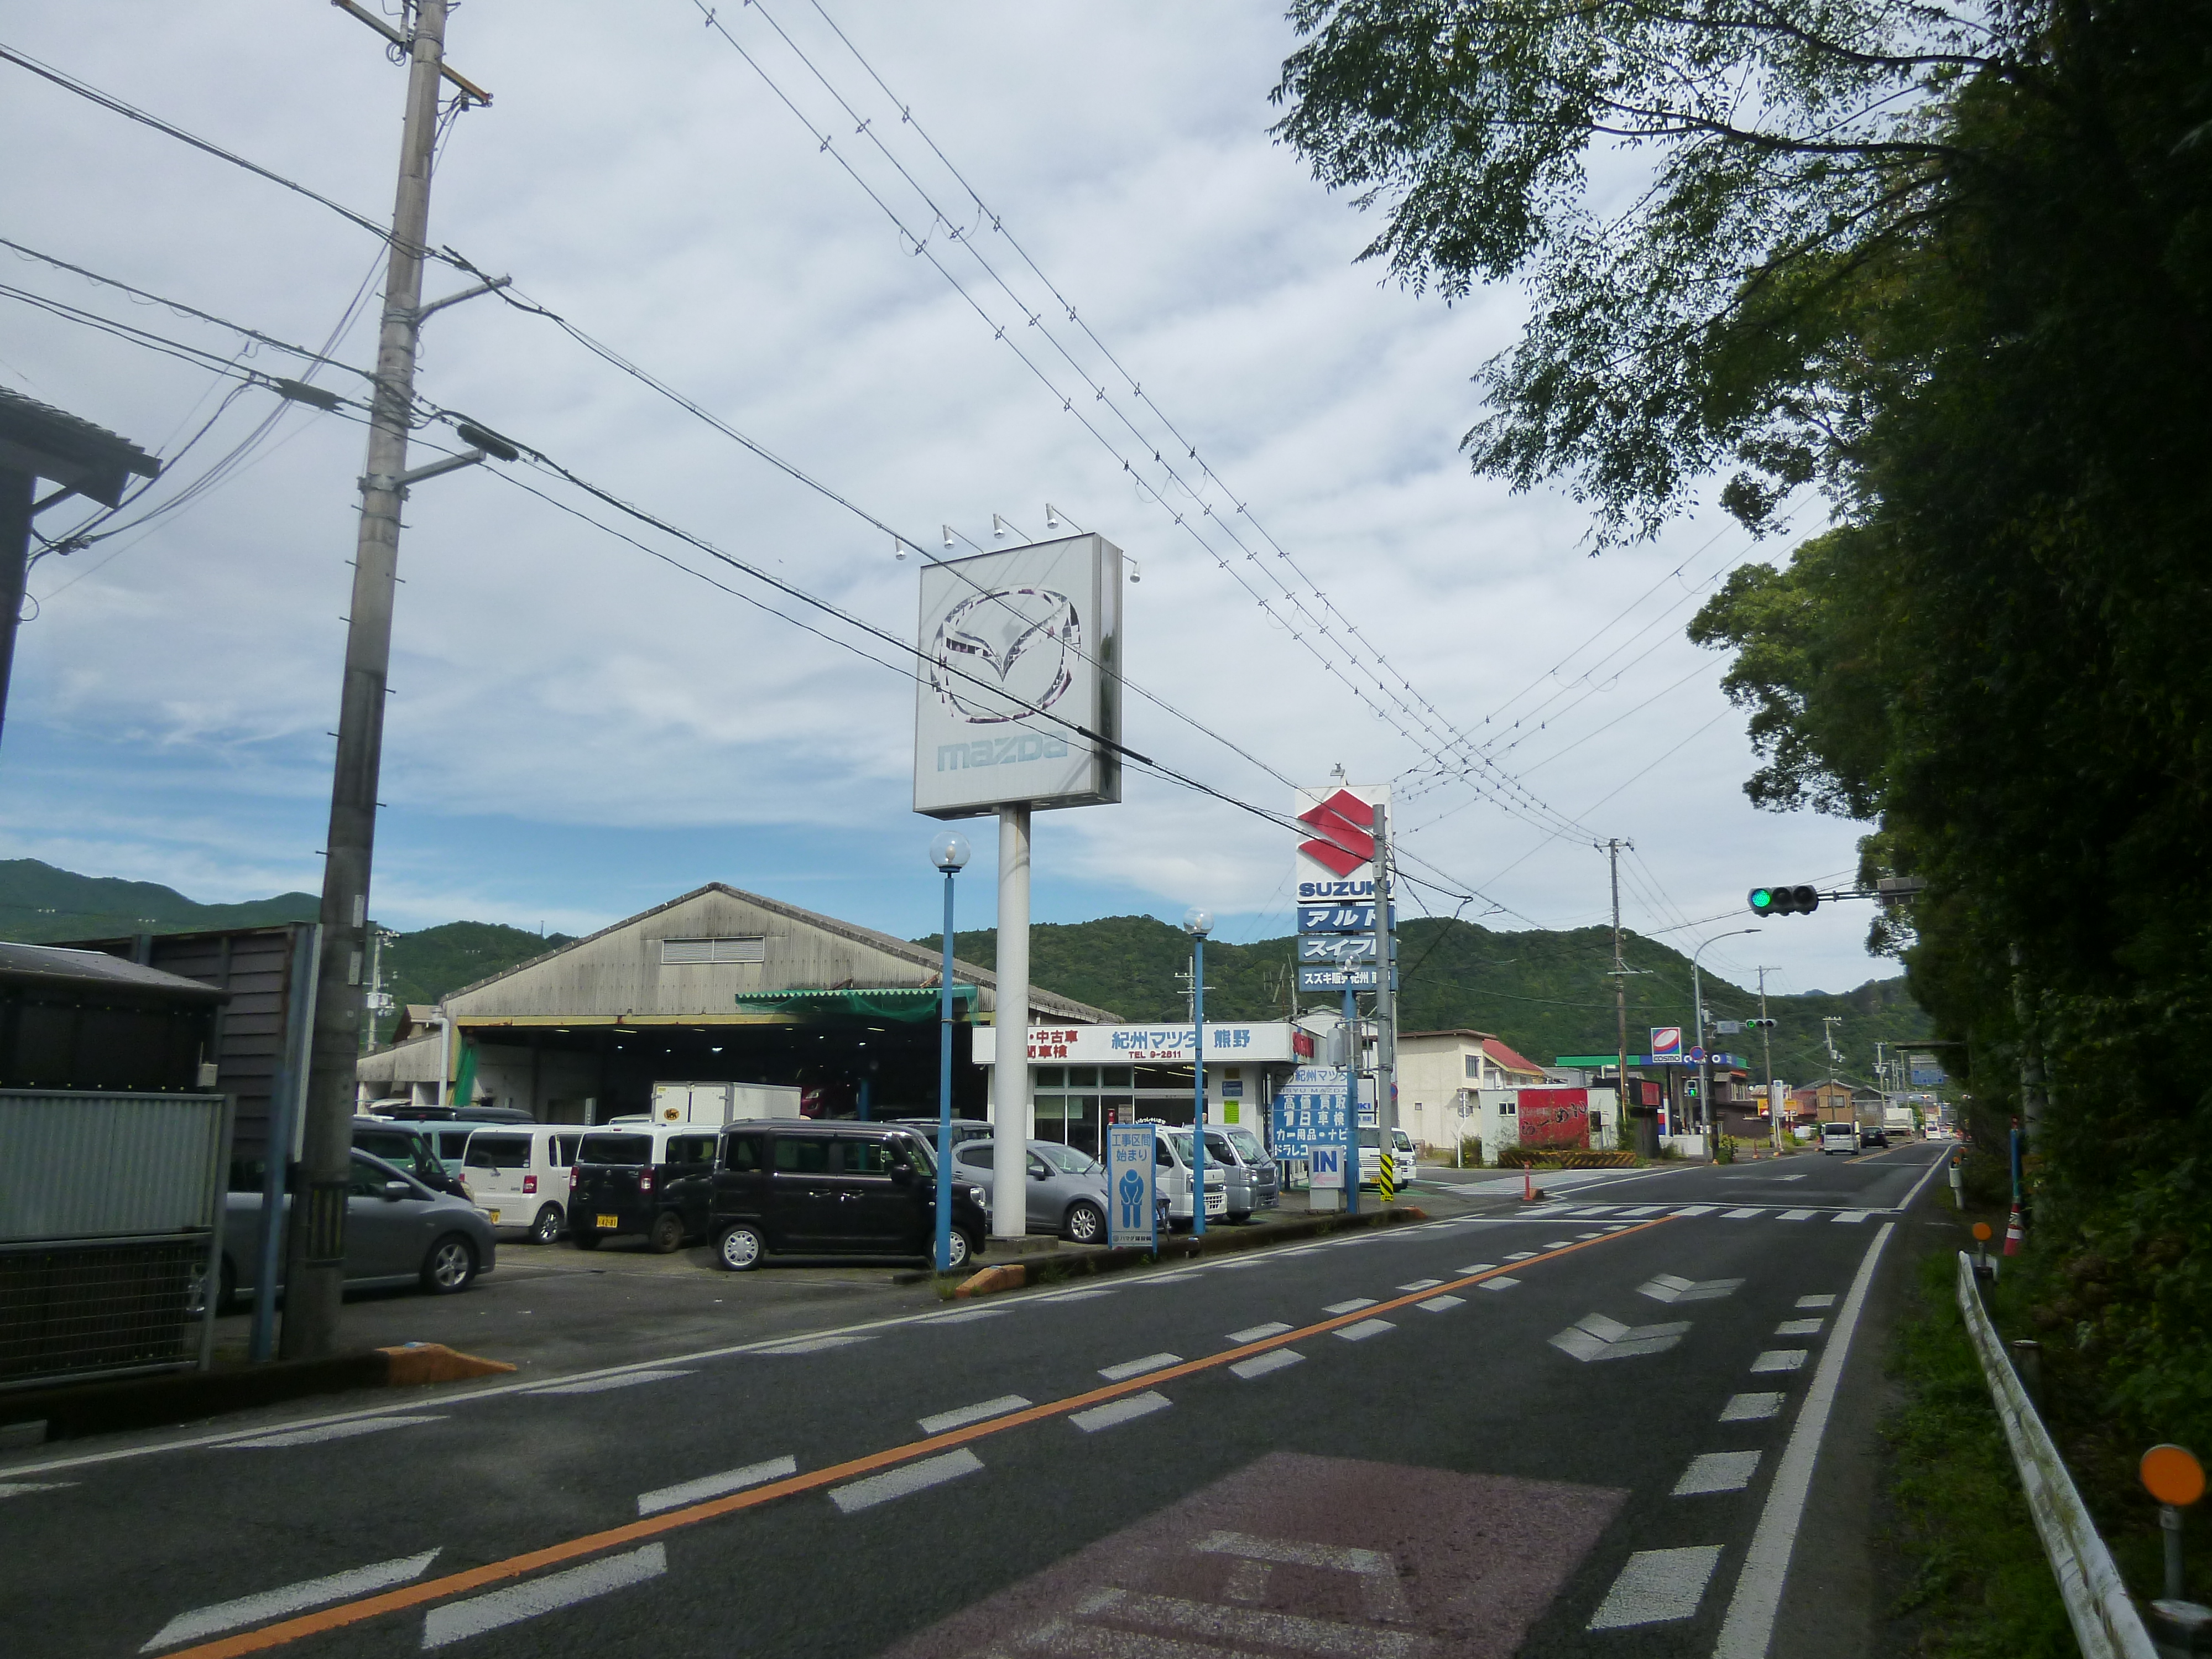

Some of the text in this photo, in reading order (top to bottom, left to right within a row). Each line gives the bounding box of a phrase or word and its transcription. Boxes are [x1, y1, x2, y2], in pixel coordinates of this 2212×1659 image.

[1214, 1029, 1250, 1048] 熊野
[1112, 1134, 1151, 1146] 工事区間
[1117, 1149, 1148, 1162] 始まり
[1312, 1150, 1338, 1172] IN
